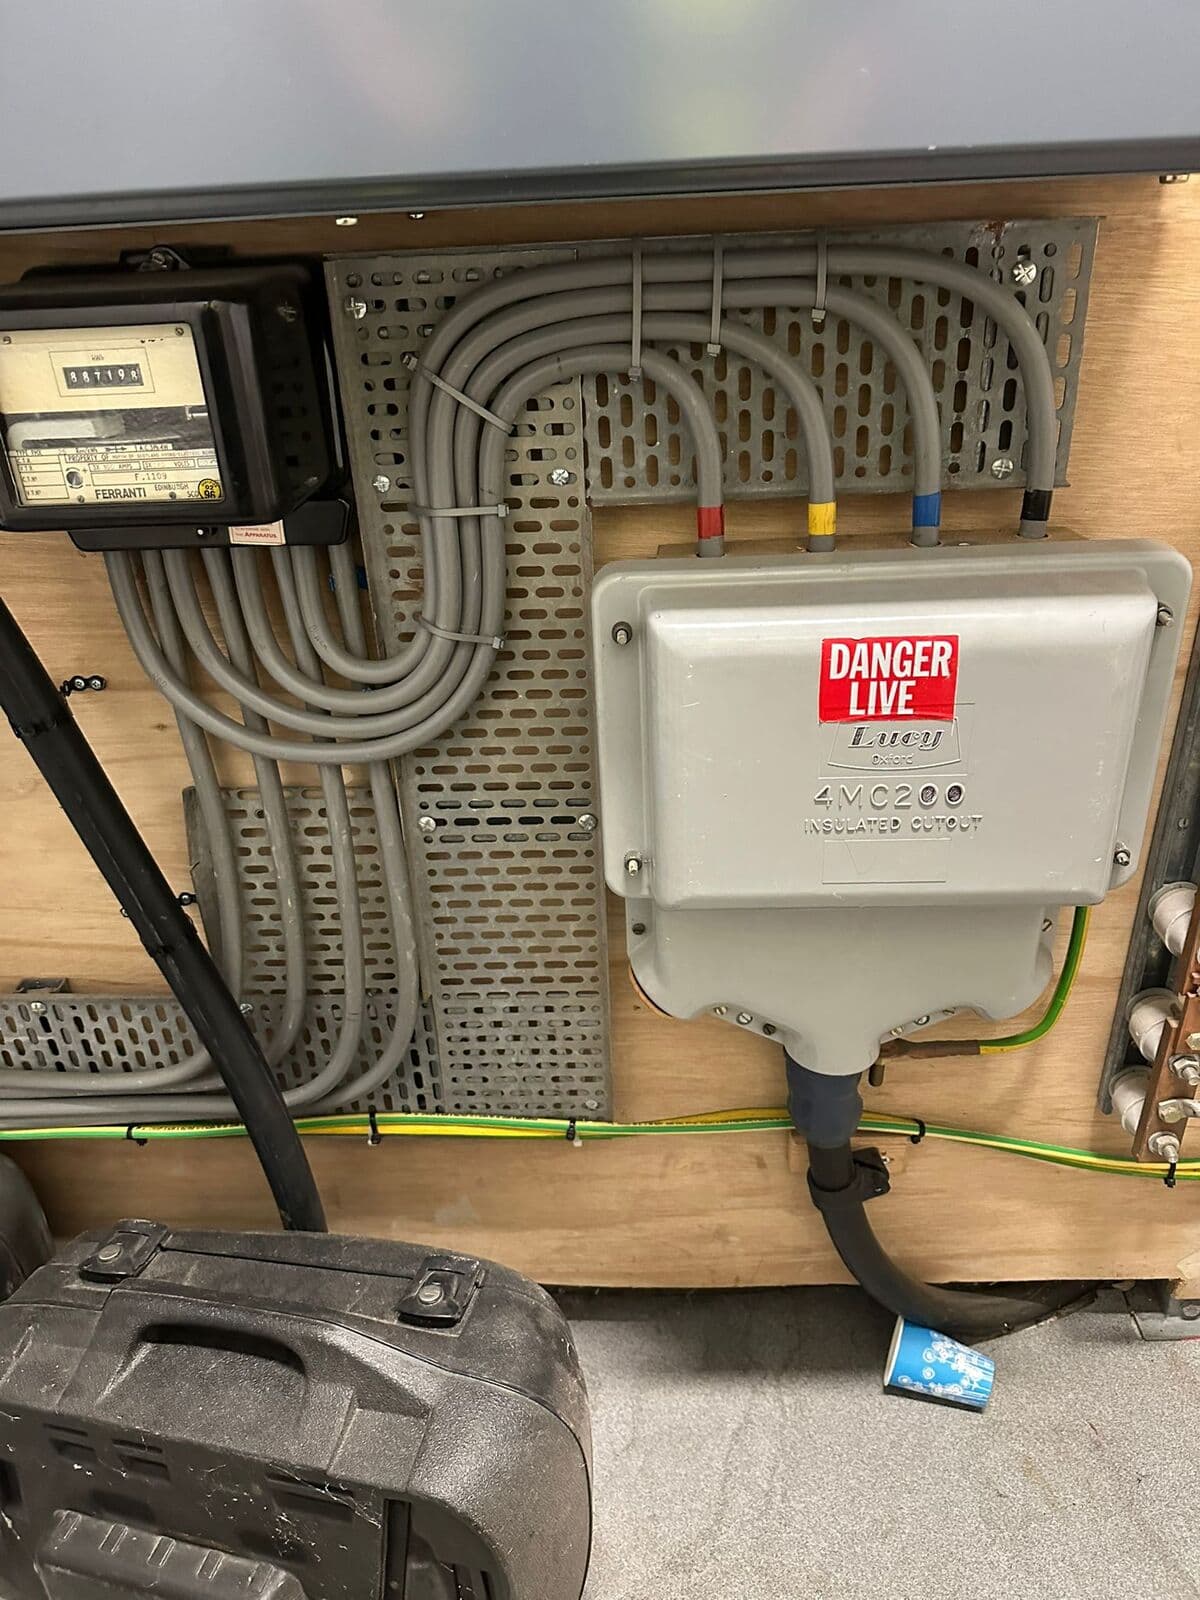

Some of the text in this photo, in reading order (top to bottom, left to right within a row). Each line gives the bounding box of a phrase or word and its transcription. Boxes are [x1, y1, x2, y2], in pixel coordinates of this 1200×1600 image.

[95, 487, 147, 499] FERRANTI
[829, 641, 953, 680] DANGER
[849, 680, 917, 715] LIVE
[847, 724, 945, 751] Lucy
[813, 783, 966, 809] 4MC200
[804, 815, 983, 834] INSULATED CUTOUT
